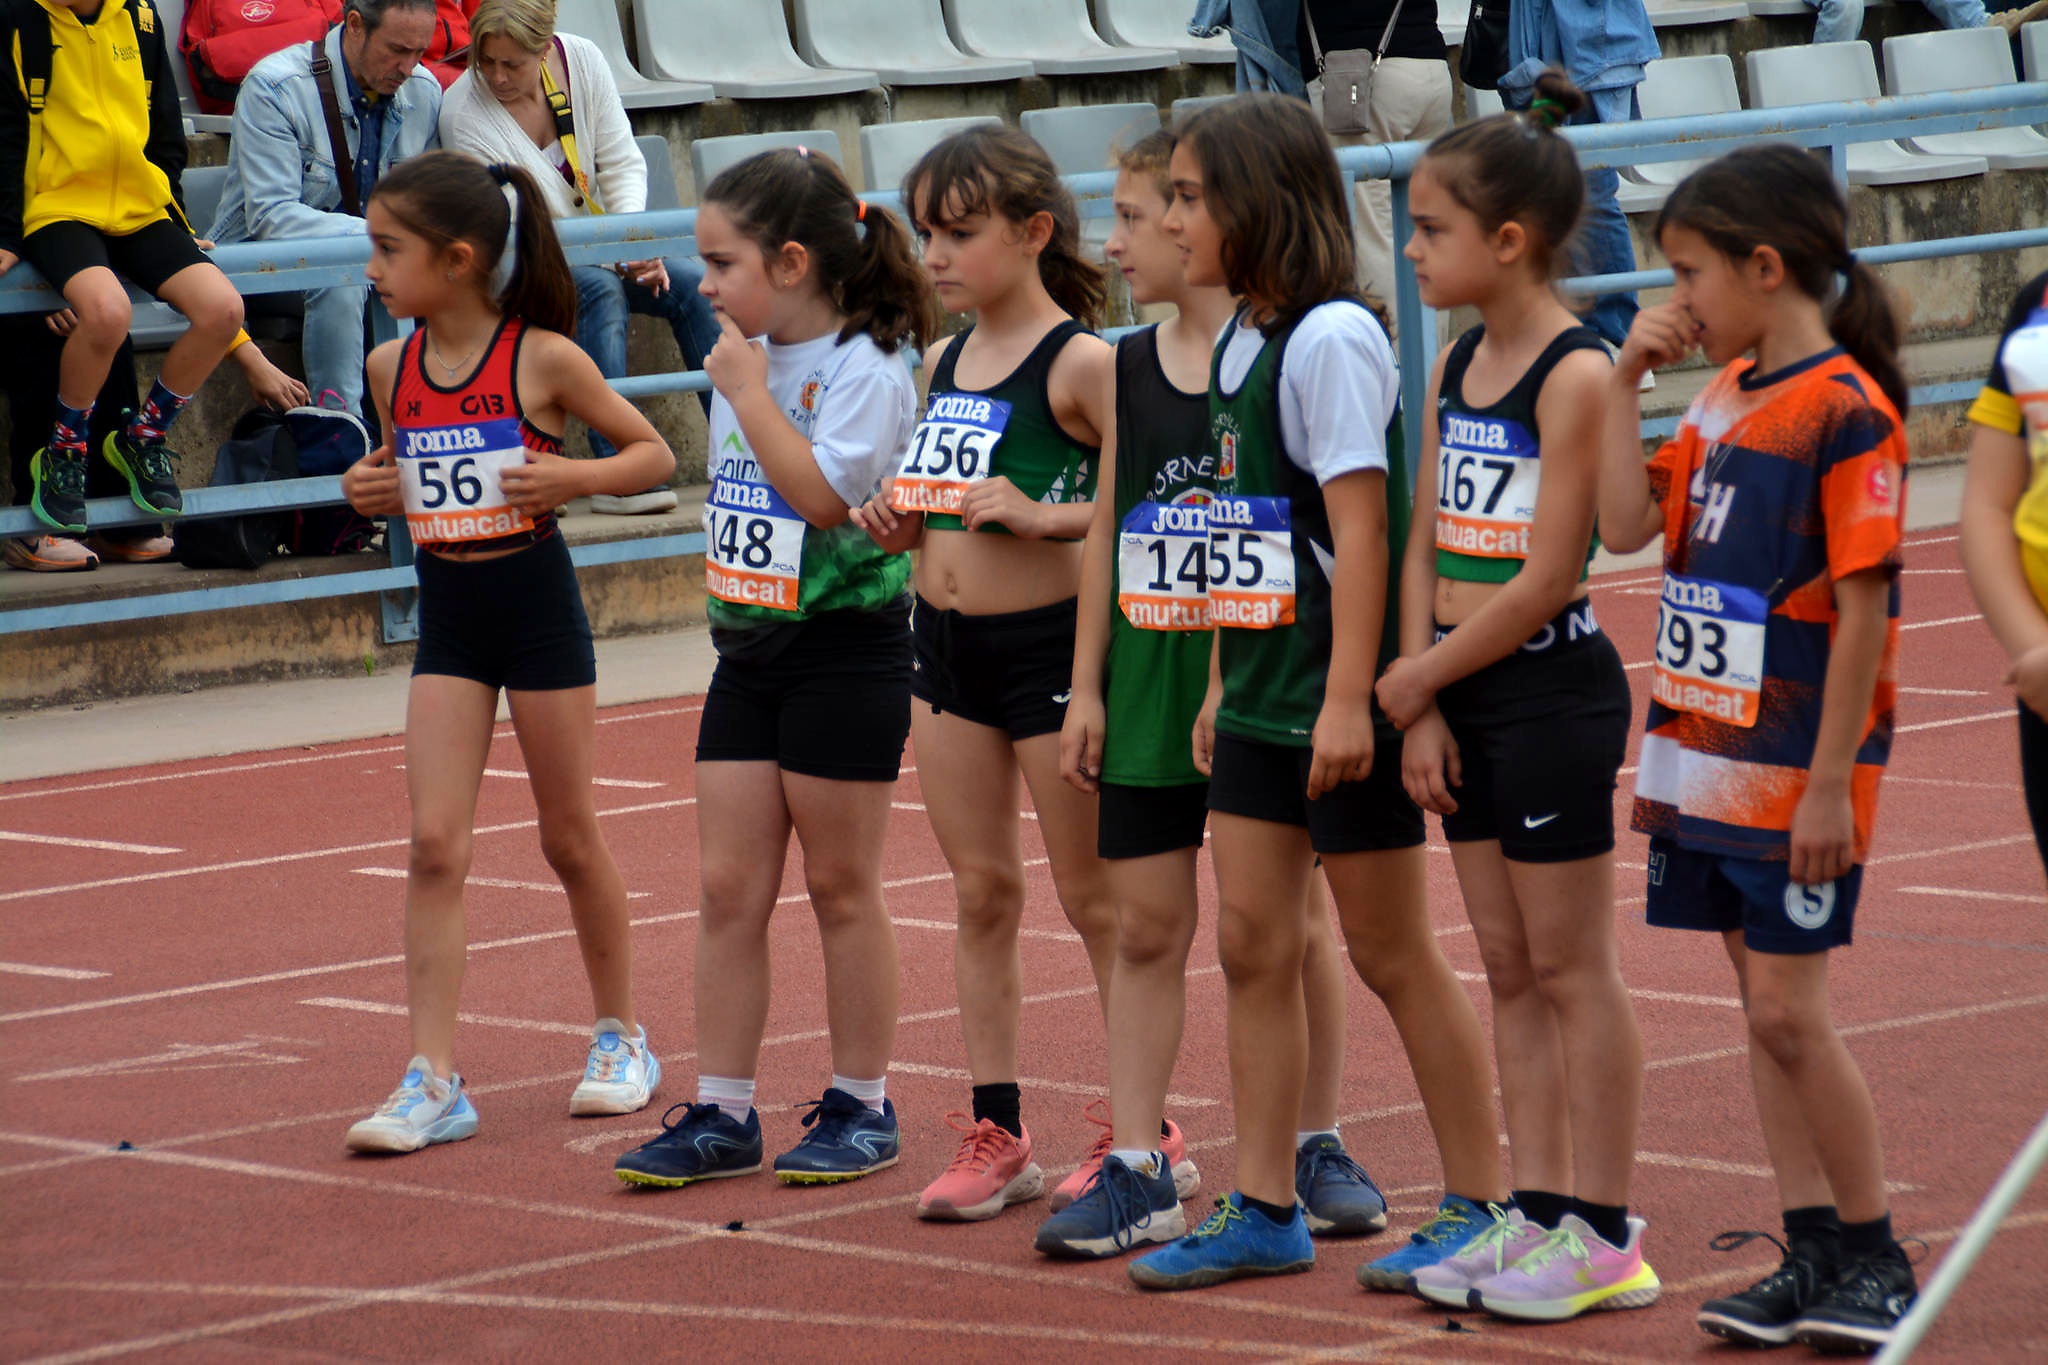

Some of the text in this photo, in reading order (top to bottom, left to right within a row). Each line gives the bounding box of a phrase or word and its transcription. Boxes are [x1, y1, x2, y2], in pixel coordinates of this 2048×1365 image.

[406, 427, 486, 457] Joma
[903, 426, 986, 478] 156
[418, 457, 483, 509] 56
[1439, 452, 1516, 514] 167
[1152, 507, 1209, 533] Jom
[1208, 498, 1254, 525] ma
[709, 510, 774, 569] 148
[1148, 538, 1209, 593] 14
[1208, 533, 1264, 587] 55
[1130, 600, 1211, 627] mutua
[1664, 574, 1724, 612] oma
